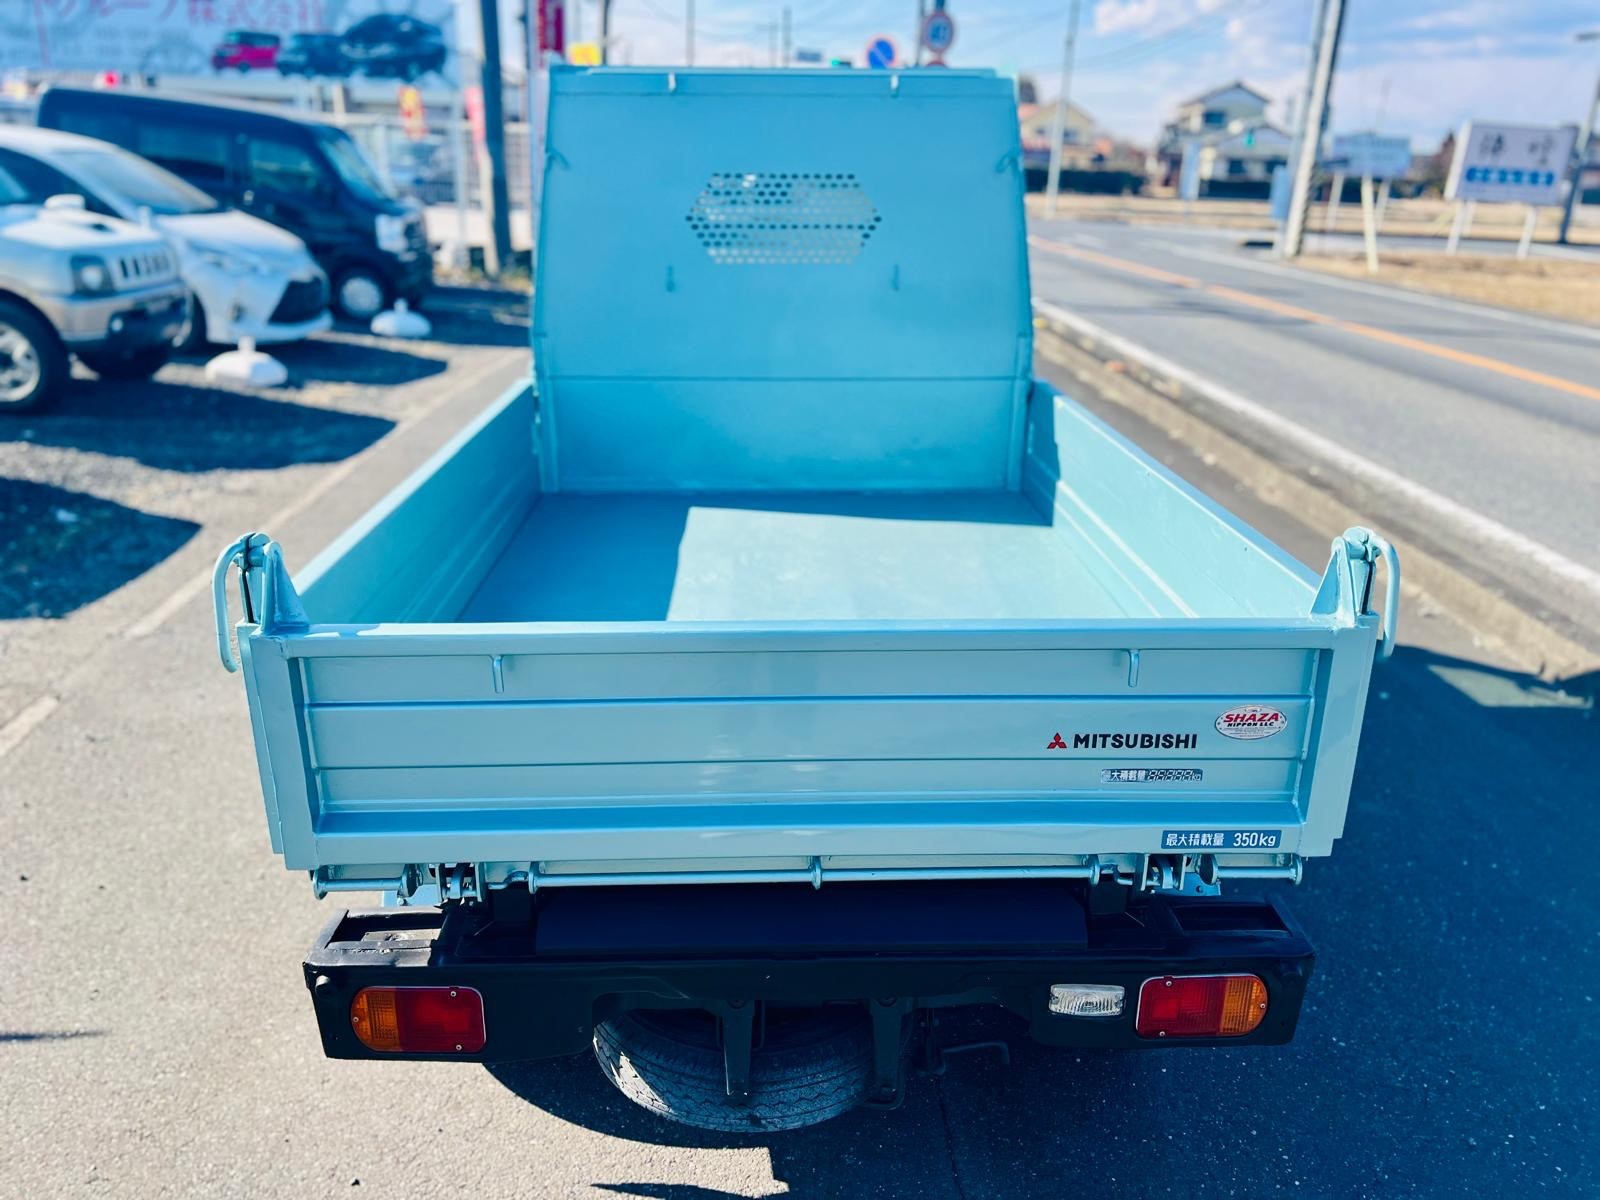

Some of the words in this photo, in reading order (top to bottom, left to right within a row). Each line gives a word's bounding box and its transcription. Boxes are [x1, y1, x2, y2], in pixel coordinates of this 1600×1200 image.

[1223, 713, 1280, 723] SHAZA
[1073, 733, 1198, 749] MITSUBISHI
[1165, 833, 1225, 847] 最大積載量
[1232, 832, 1277, 847] 350kg
